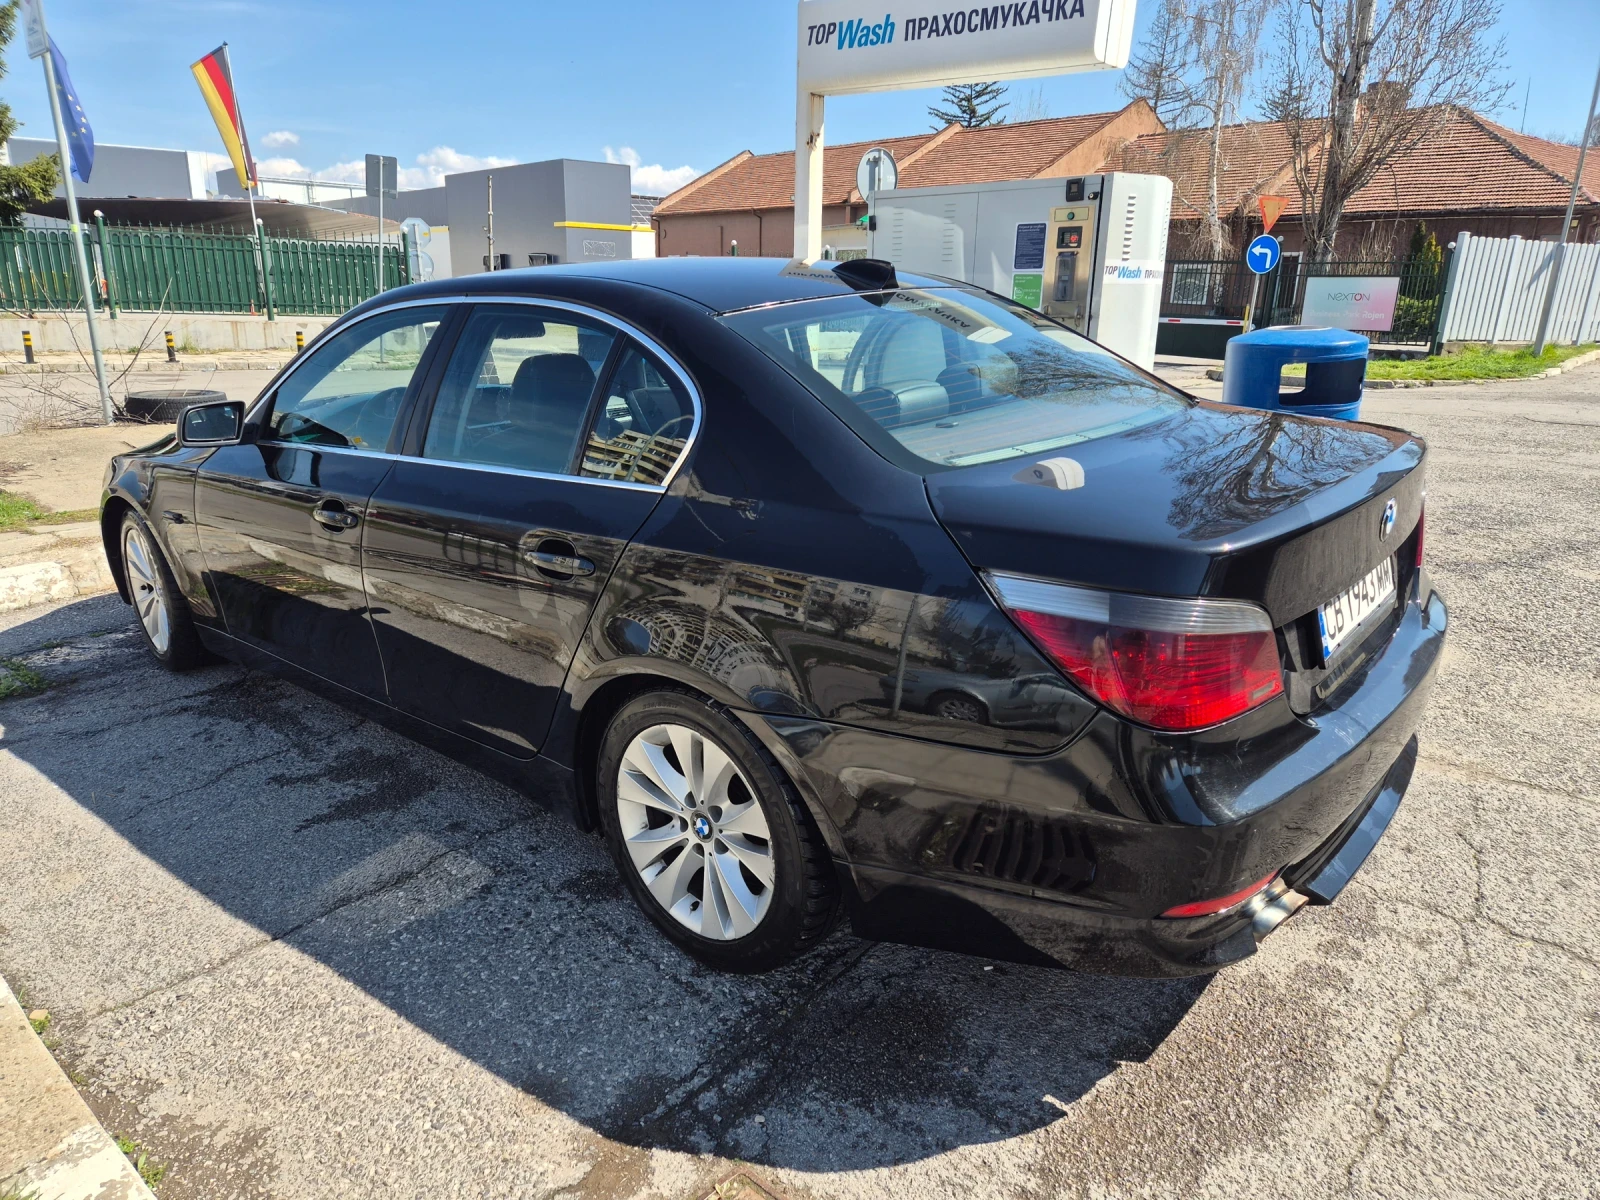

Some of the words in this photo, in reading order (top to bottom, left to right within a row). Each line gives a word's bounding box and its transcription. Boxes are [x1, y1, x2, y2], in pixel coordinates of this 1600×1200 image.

[904, 0, 1085, 41] ПРАХОСМУКАЧКА
[1362, 311, 1385, 321] Rojen
[1324, 595, 1345, 640] CB
[1345, 570, 1376, 622] 1943
